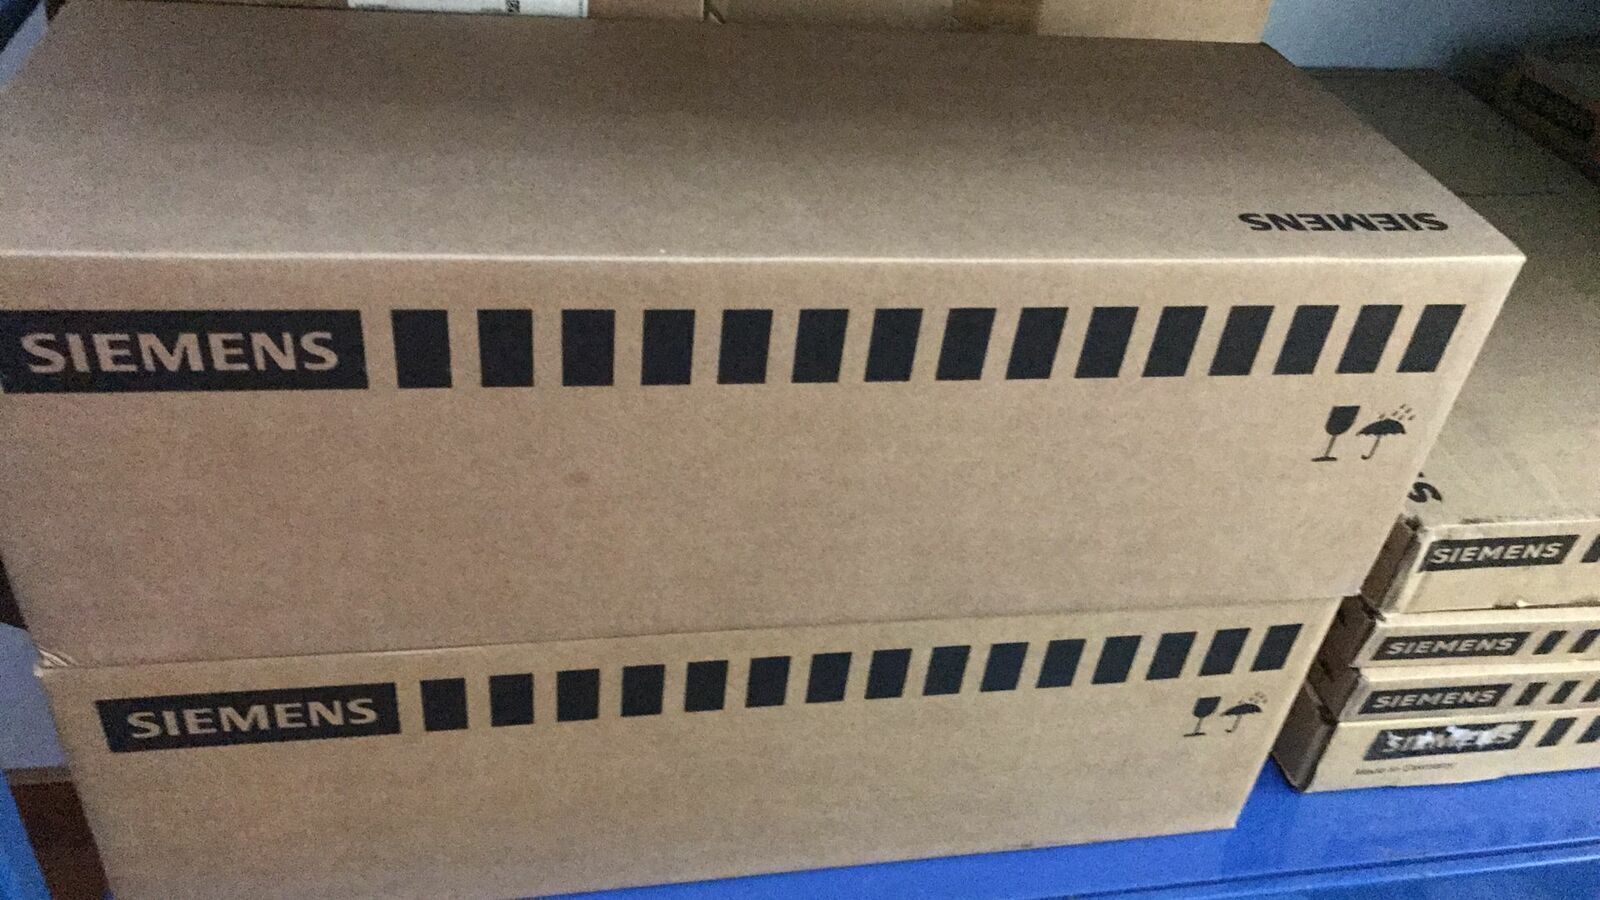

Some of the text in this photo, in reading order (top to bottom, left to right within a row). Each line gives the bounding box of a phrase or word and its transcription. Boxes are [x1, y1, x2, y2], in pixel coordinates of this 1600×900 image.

[1238, 212, 1449, 231] SIEMENS
[20, 331, 339, 373] SIEMENS
[1431, 541, 1563, 564] SIEMENS
[1387, 637, 1517, 655] SIEMENS
[1371, 690, 1498, 709] SIEMENS
[127, 698, 379, 739] SIEMENS
